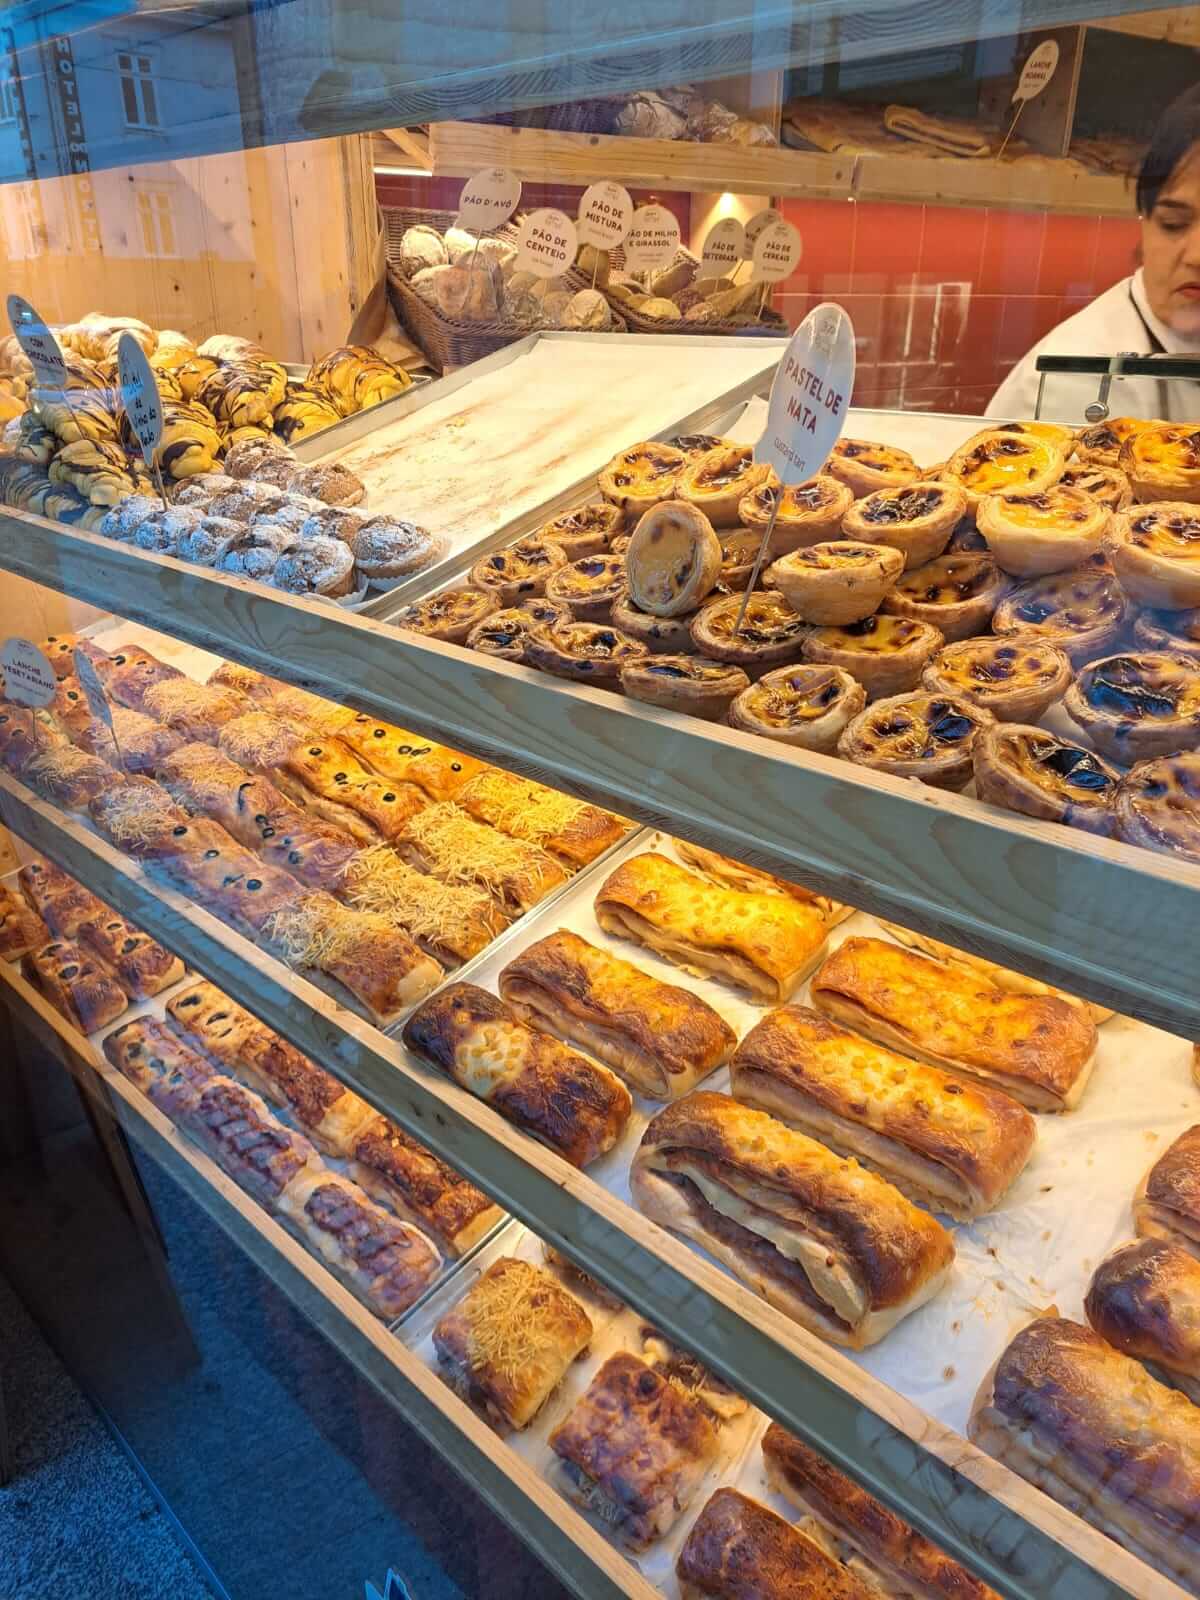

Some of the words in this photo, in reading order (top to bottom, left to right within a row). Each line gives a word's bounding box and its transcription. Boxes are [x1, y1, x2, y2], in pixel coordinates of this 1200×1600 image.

[464, 194, 484, 206] PÃO
[592, 200, 611, 215] PÃO
[611, 207, 624, 219] DE
[585, 211, 623, 233] MISTURA
[532, 228, 553, 243] PÃO
[554, 237, 568, 249] DE
[654, 230, 678, 238] MILHO
[525, 240, 567, 261] CENTEIO
[711, 241, 726, 251] PÃO
[726, 244, 736, 252] DE
[766, 241, 782, 251] PÃO
[782, 244, 792, 252] DE
[762, 251, 790, 262] CEREAIS
[784, 357, 824, 402] PASTEL
[824, 388, 843, 416] DE
[787, 395, 817, 435] NATA
[12, 658, 41, 676] LANCHE
